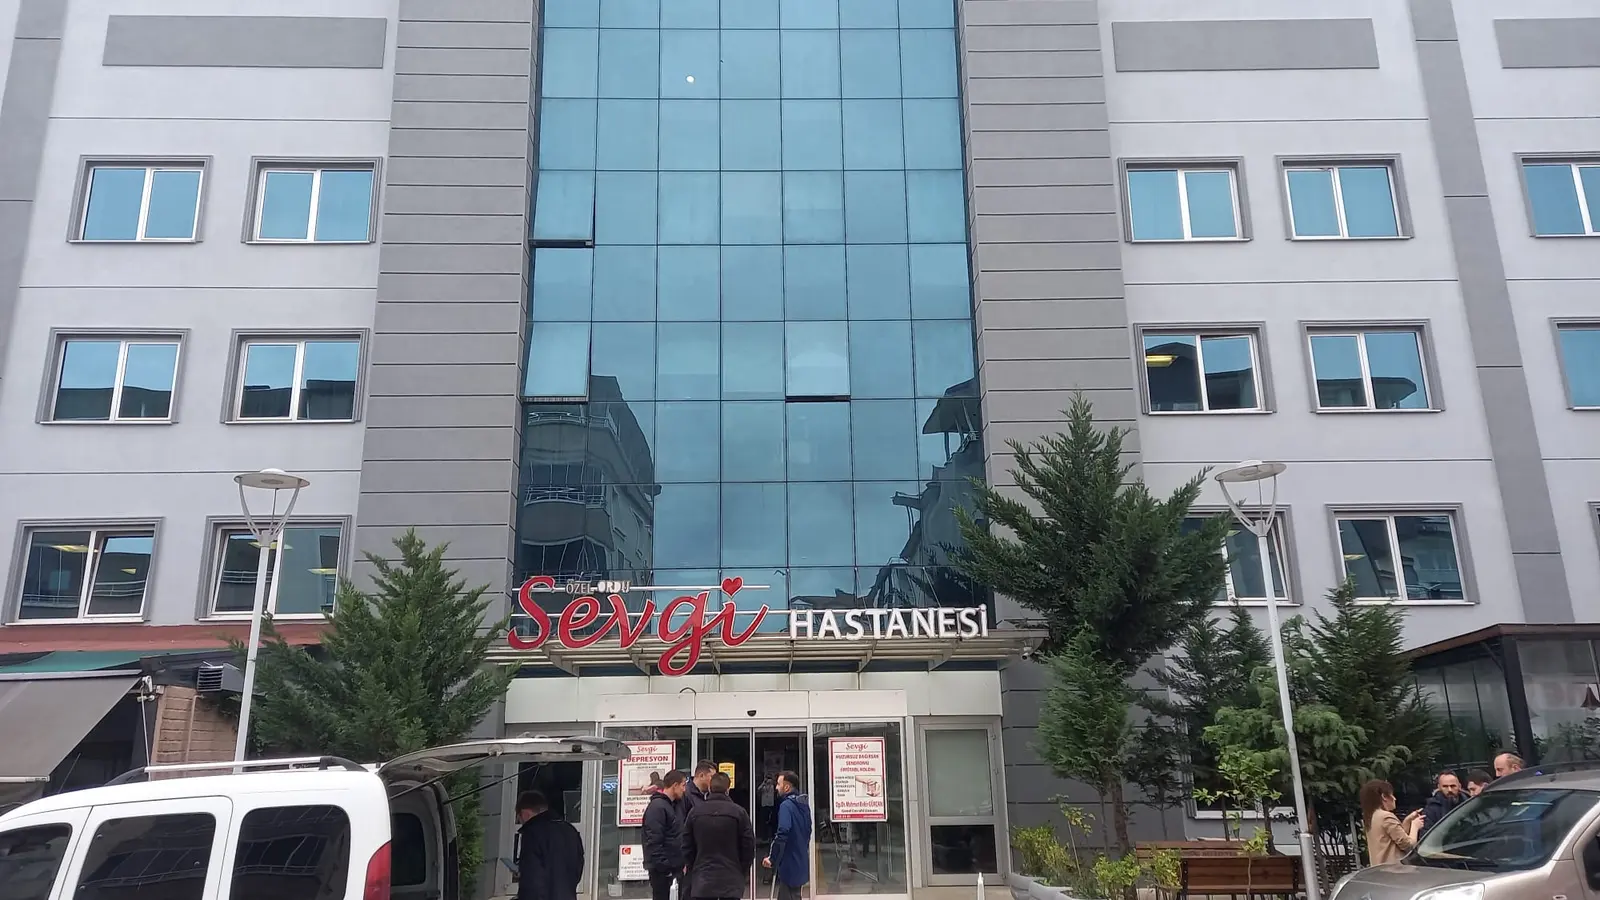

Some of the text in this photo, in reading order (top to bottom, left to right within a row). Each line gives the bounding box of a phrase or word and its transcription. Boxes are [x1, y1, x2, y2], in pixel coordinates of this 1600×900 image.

[566, 579, 631, 594] ÖZEL ORDU
[507, 575, 989, 677] Sevgi HASTANESİ
[626, 755, 669, 763] DEPRESYON
